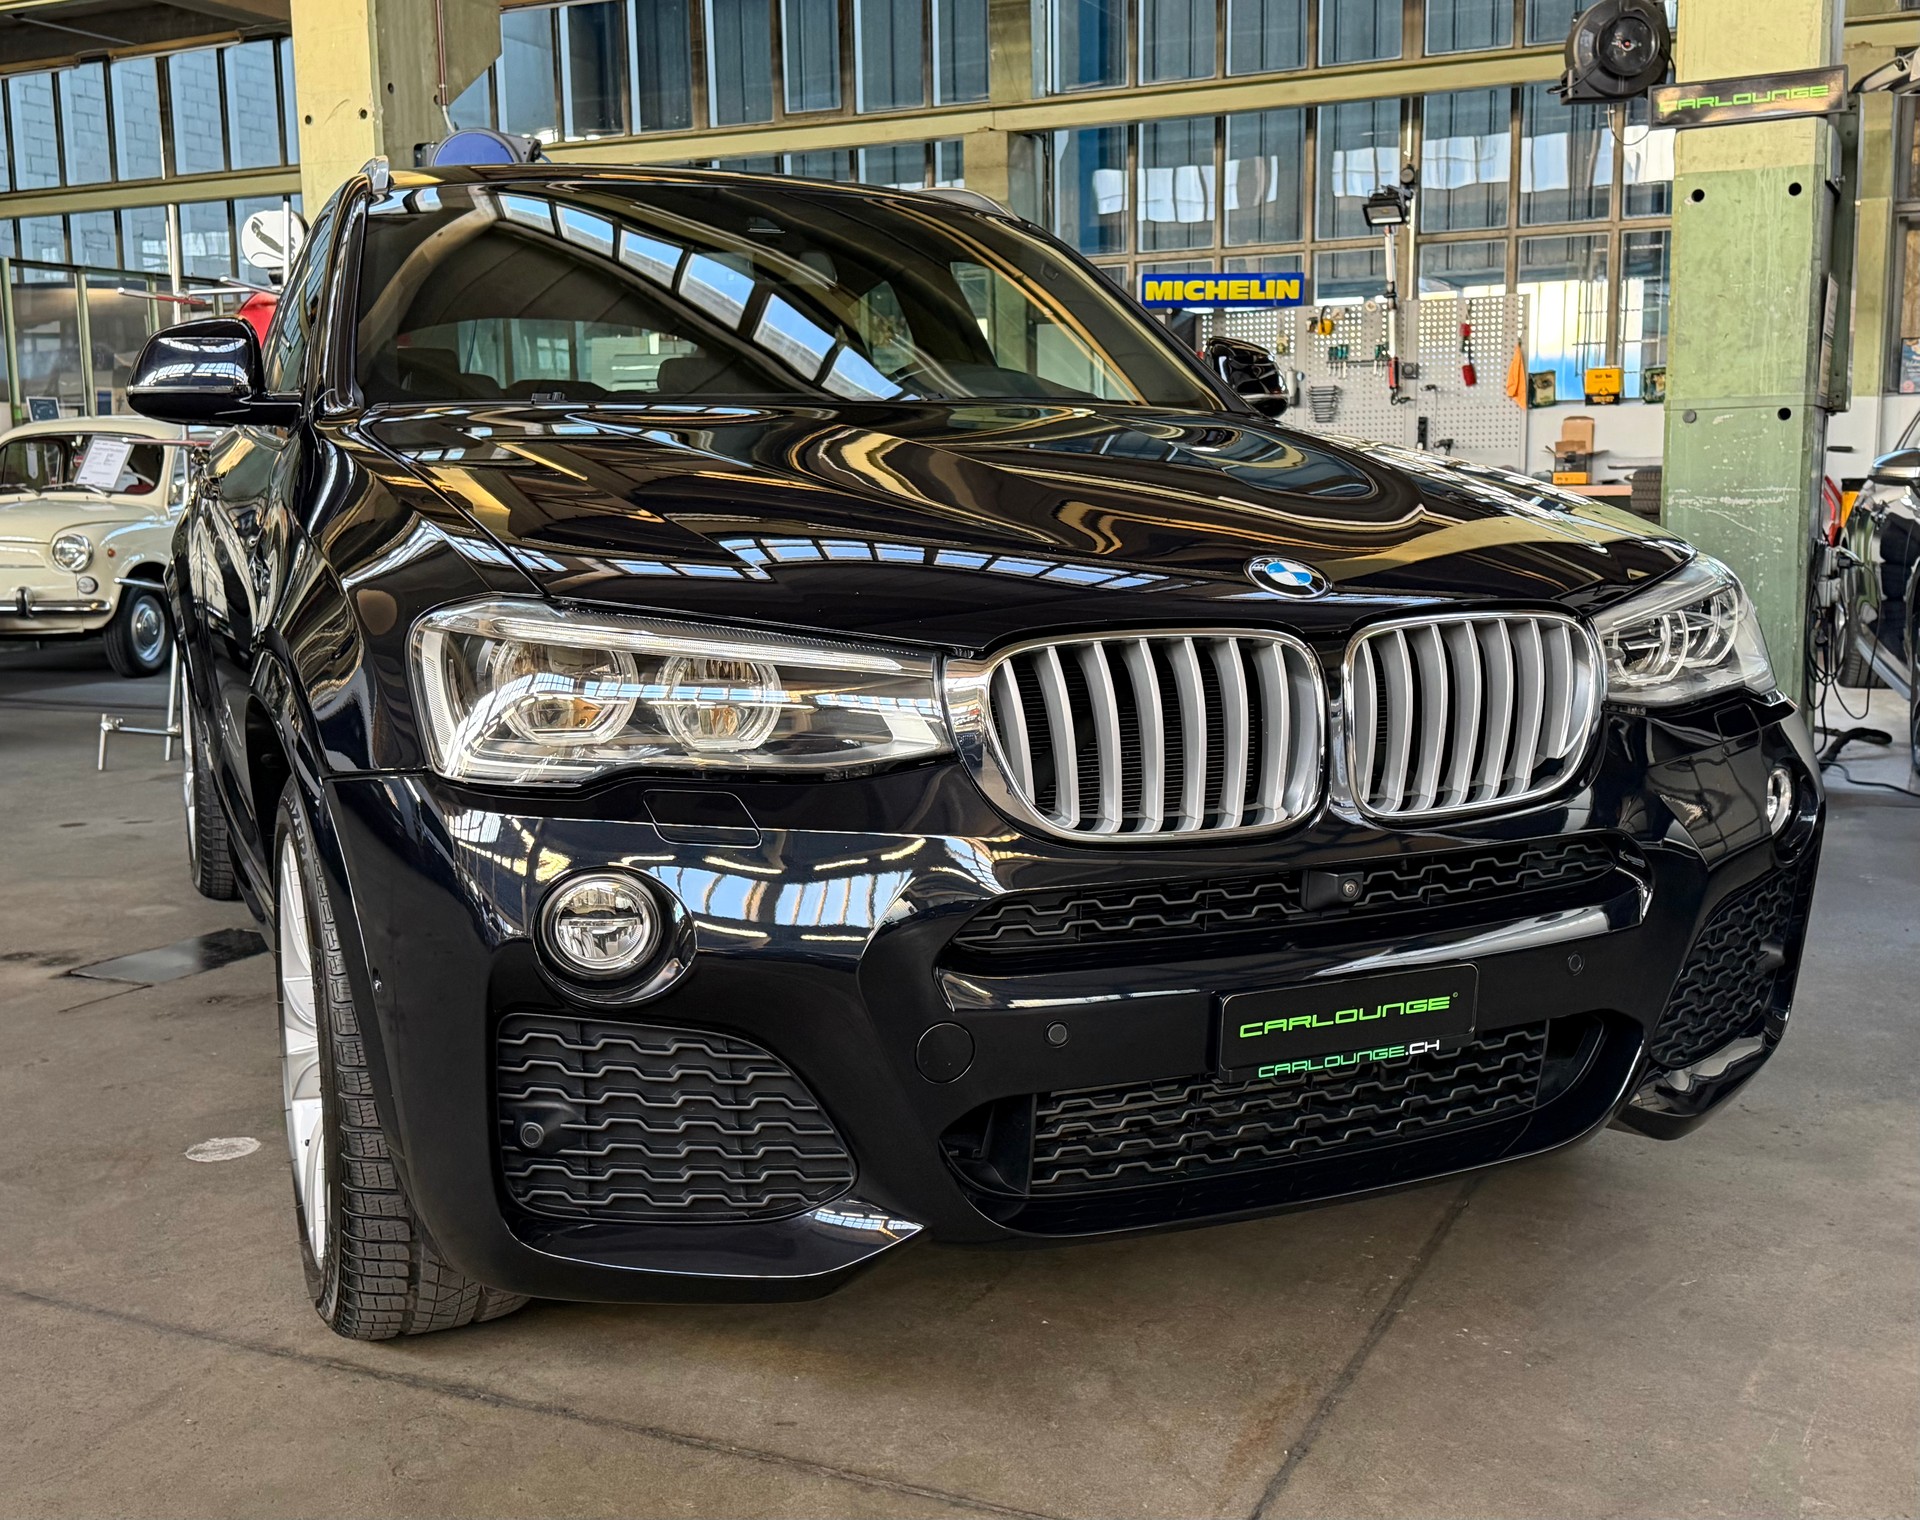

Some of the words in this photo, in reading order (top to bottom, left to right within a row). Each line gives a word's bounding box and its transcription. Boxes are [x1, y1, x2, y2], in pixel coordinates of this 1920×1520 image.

[1659, 85, 1829, 112] CARLOUNGE
[1145, 280, 1300, 301] MICHELIN
[1239, 996, 1451, 1038] CARLOUNGE
[1258, 1039, 1440, 1079] CARLOUNGE.CH
